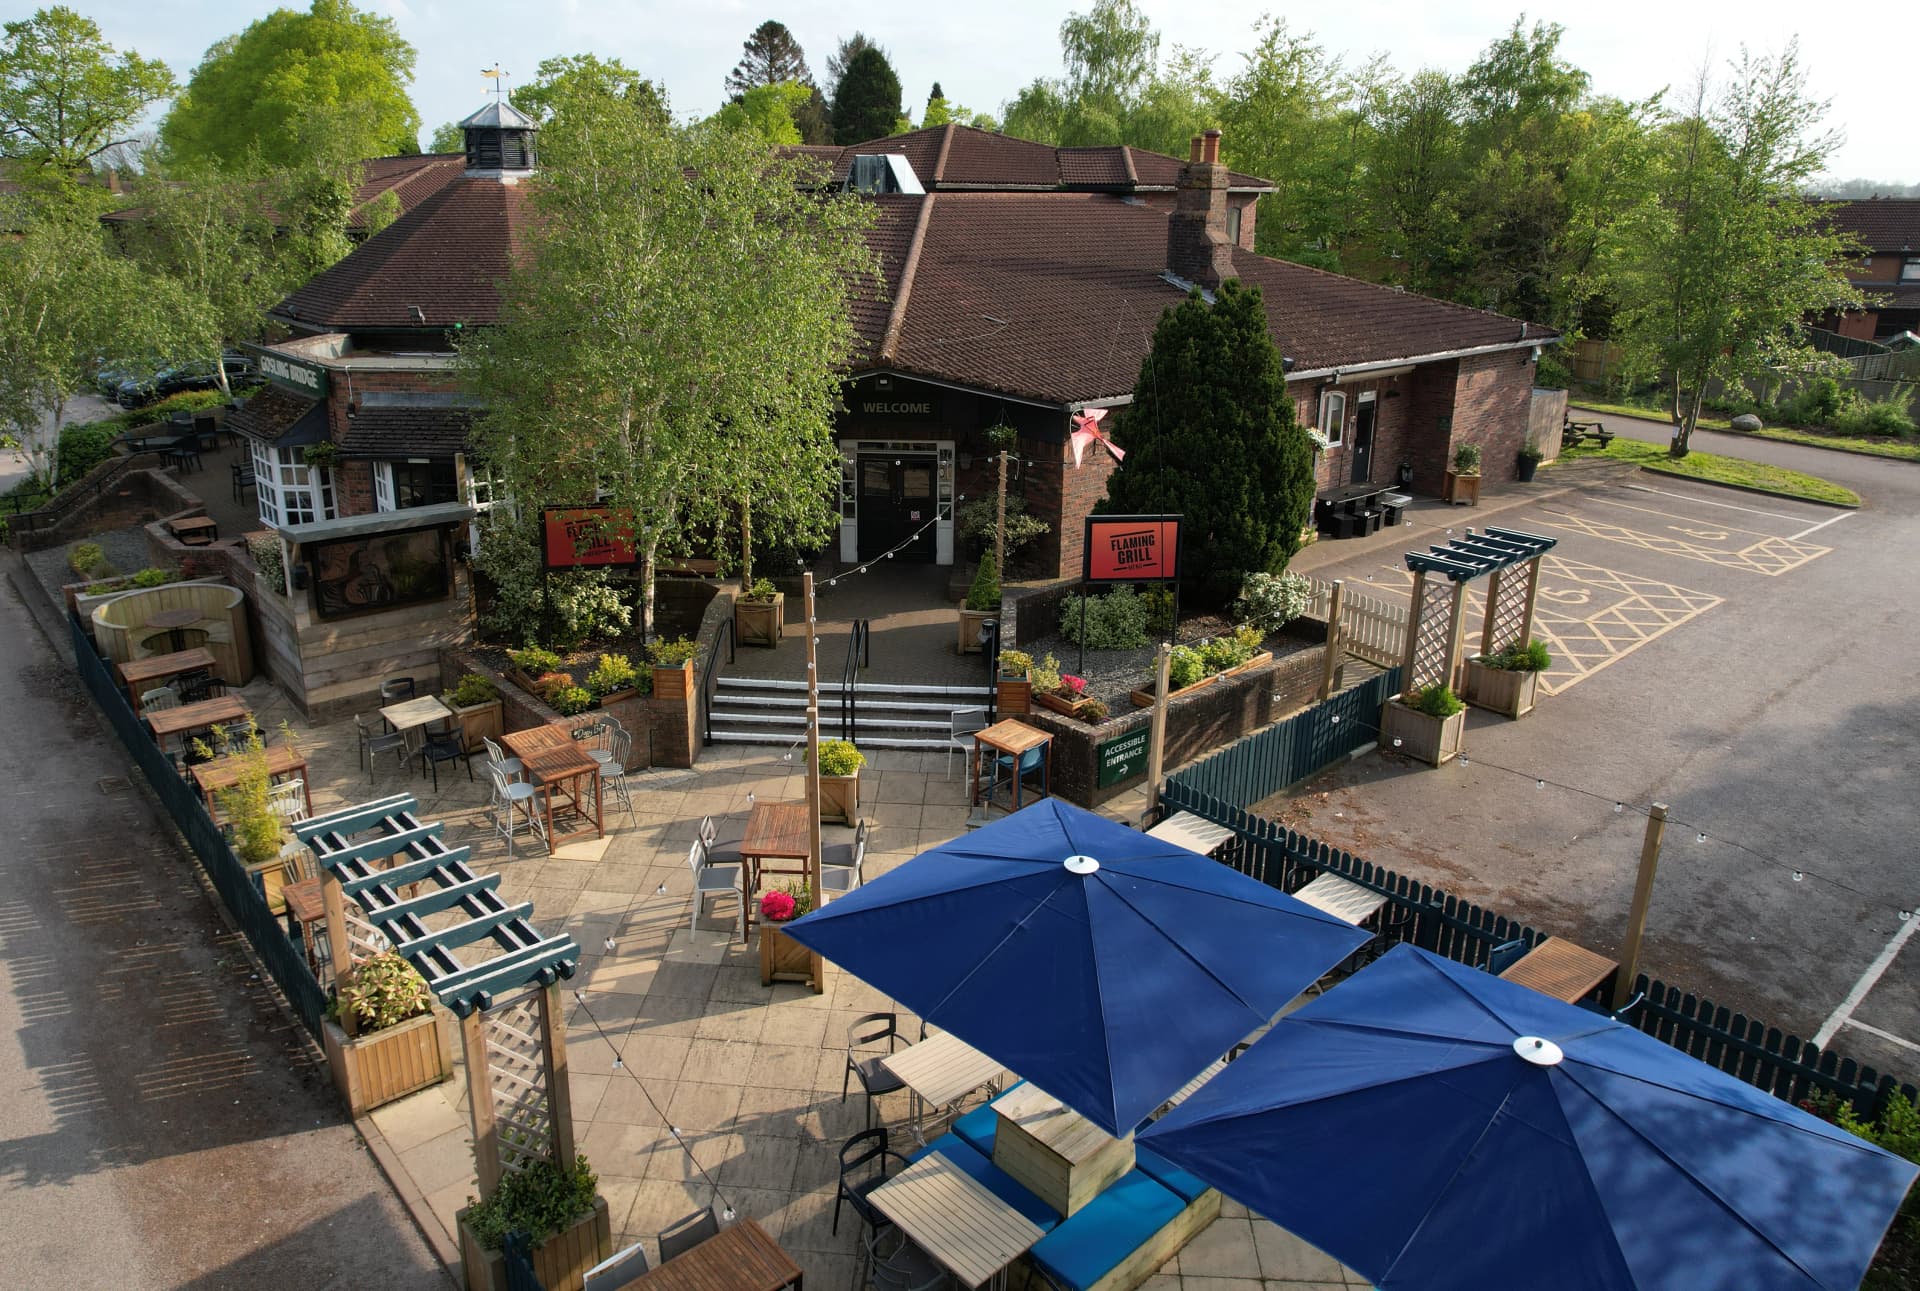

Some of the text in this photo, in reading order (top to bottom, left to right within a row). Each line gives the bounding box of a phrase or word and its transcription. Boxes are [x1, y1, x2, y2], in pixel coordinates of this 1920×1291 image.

[261, 356, 318, 389] GOSLING BRIDGE
[863, 402, 931, 414] WELCOME
[1111, 534, 1155, 551] FLAMING
[1118, 547, 1152, 565] GRILL
[1104, 735, 1146, 757] ACCESSIBLE
[1106, 747, 1144, 767] ENTRANCE
